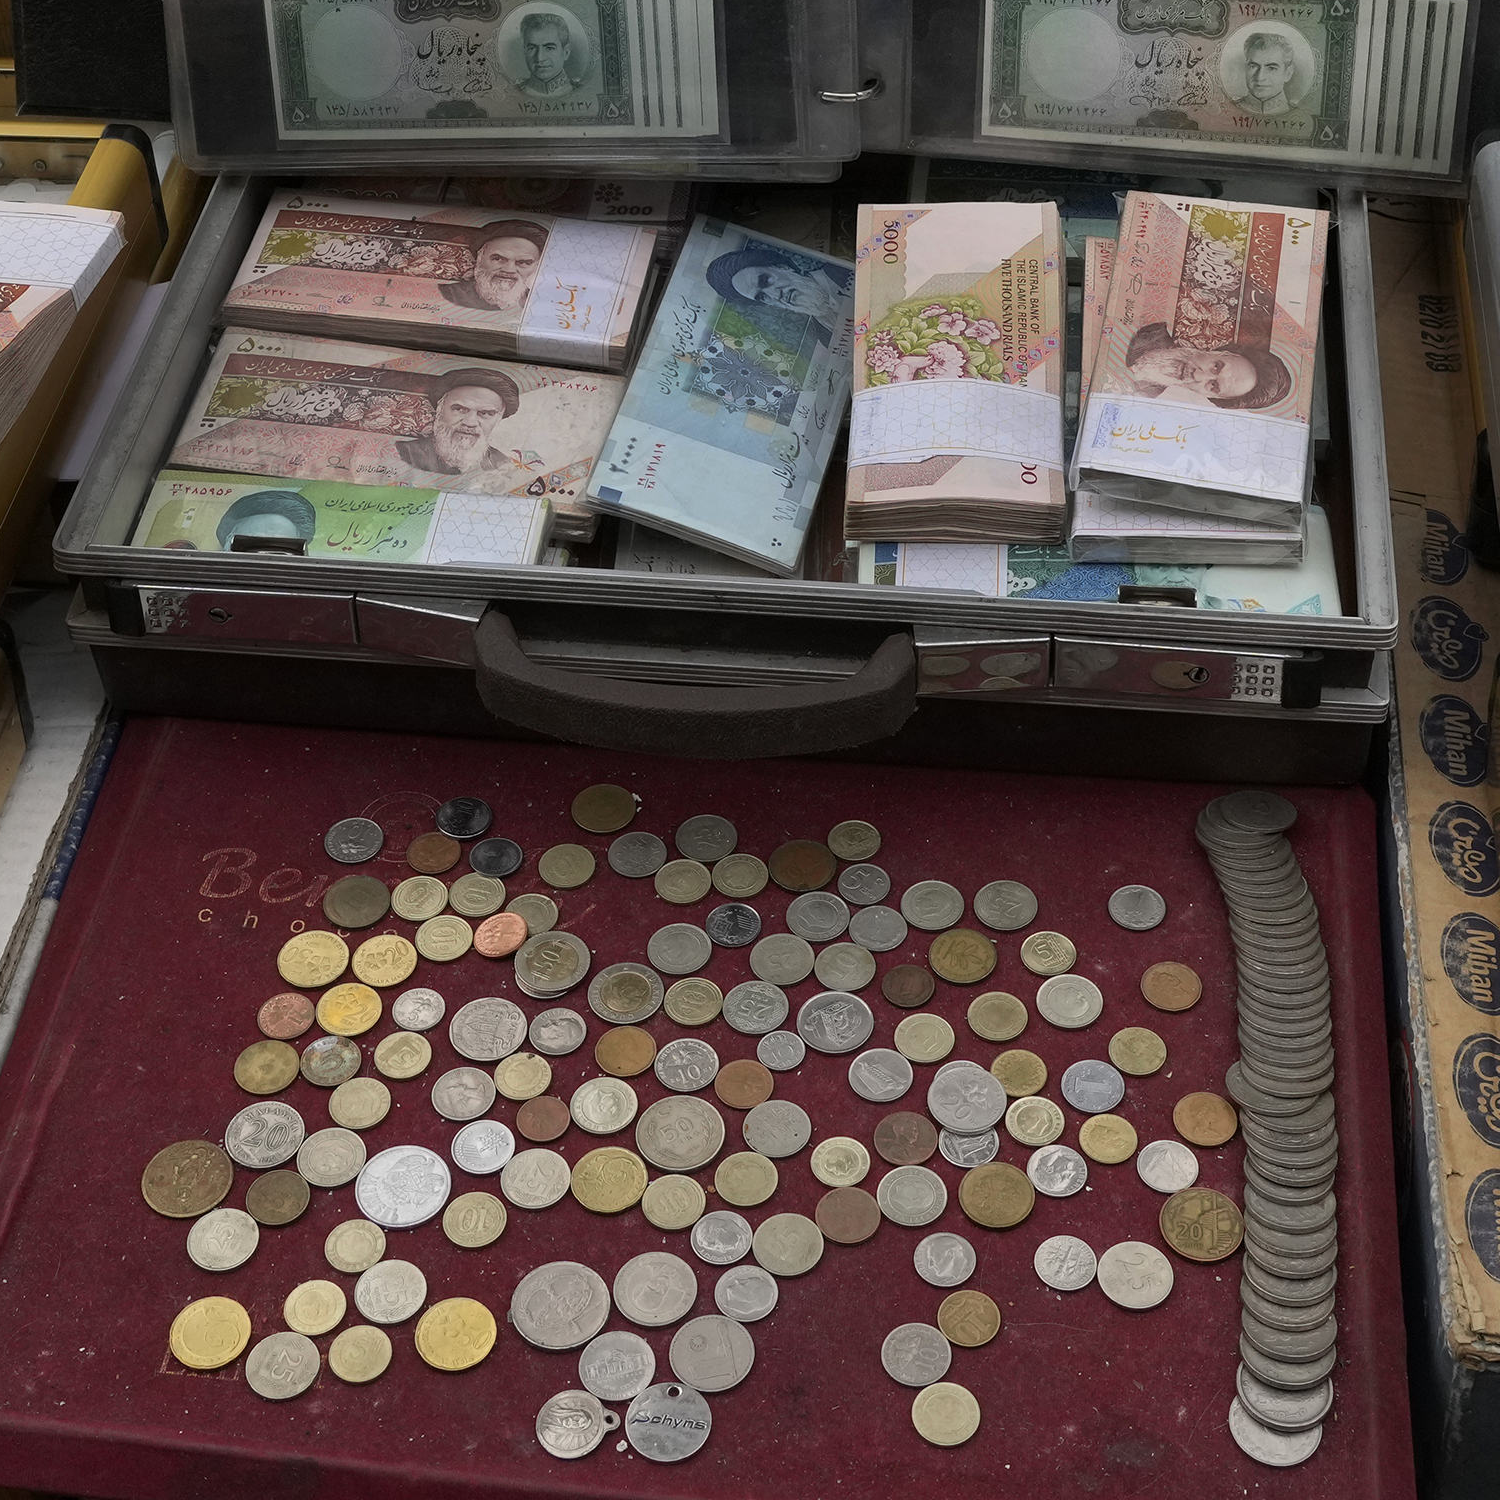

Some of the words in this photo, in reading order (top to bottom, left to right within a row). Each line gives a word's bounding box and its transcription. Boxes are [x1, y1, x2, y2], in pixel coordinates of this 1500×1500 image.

[417, 29, 455, 65] ریال
[456, 32, 486, 67] پنجاه
[1135, 39, 1174, 76] ریال
[1175, 46, 1204, 79] پنجاه
[286, 195, 330, 209] ۵۰۰۰
[605, 203, 653, 217] 2000
[294, 215, 319, 229] ایران
[317, 215, 350, 230] اسلامی
[343, 217, 376, 233] جمهوری
[371, 218, 400, 233] مرکزی
[394, 222, 427, 238] بانک
[1286, 216, 1312, 245] ۵۰۰۰
[316, 241, 343, 261] ریال
[360, 241, 381, 261] پنج
[881, 218, 899, 266] 5000
[1001, 258, 1012, 277] FIVE
[1016, 258, 1026, 274] THE
[1028, 258, 1039, 297] CENTRAL
[1001, 277, 1013, 333] THOUSAND
[1016, 275, 1027, 312] ISLAMIC
[1029, 297, 1040, 322] BANK
[1017, 312, 1028, 354] REPUBLIC
[1030, 324, 1040, 335] OF
[236, 336, 282, 352] ۵۰۰۰
[1002, 333, 1014, 362] RIALS
[1018, 354, 1028, 368] OF
[1111, 424, 1142, 442] ایران
[1152, 424, 1201, 450] بانک
[526, 475, 575, 497] ۵۰۰۰
[327, 521, 368, 552] ریال
[391, 536, 408, 549] ده
[1424, 520, 1451, 577] Mihan
[1442, 708, 1474, 777] Mihan
[385, 940, 410, 965] 20
[1465, 928, 1498, 1004] Mihan
[677, 1064, 701, 1085] 10
[241, 1118, 290, 1151] 20
[660, 1117, 695, 1143] 50
[206, 1225, 236, 1253] 25
[1175, 1222, 1201, 1239] 20
[271, 1349, 303, 1383] 25
[630, 1410, 708, 1431] Schyns
